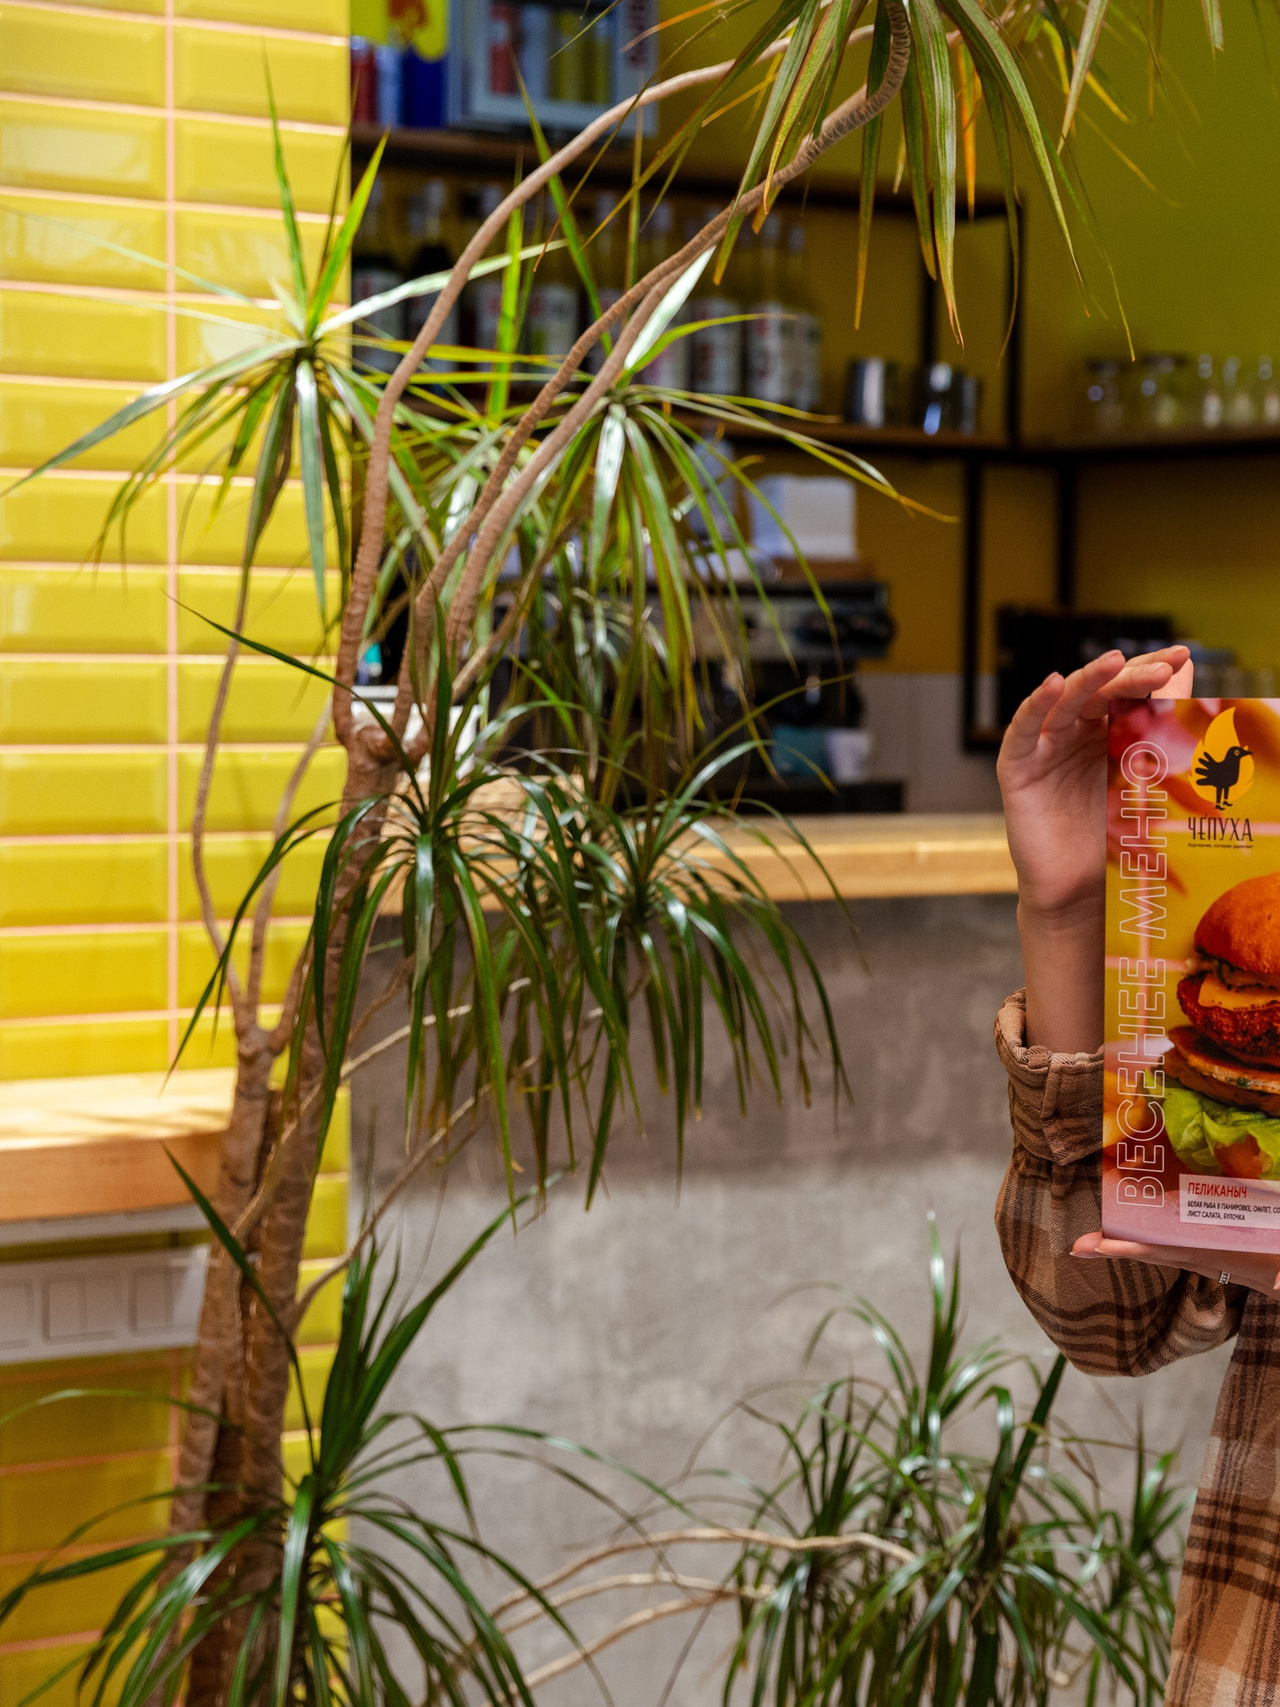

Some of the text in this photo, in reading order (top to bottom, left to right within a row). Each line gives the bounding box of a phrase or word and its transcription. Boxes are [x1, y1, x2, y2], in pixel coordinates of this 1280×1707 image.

[1116, 740, 1169, 1208] ВЕСЕНЕЕ МЕНЮ
[1187, 1182, 1248, 1198] ПЕЛИКАНЫЧ
[1187, 1200, 1202, 1208] БЕЛАЯ
[1203, 1201, 1216, 1209] РЫБА
[1220, 1203, 1252, 1212] ПАНИРОВКЕ,
[1253, 1205, 1272, 1214] ОМЛЕТ,
[1201, 1211, 1222, 1220] САЛАТА,
[1223, 1213, 1246, 1221] БУЛОЧКА
